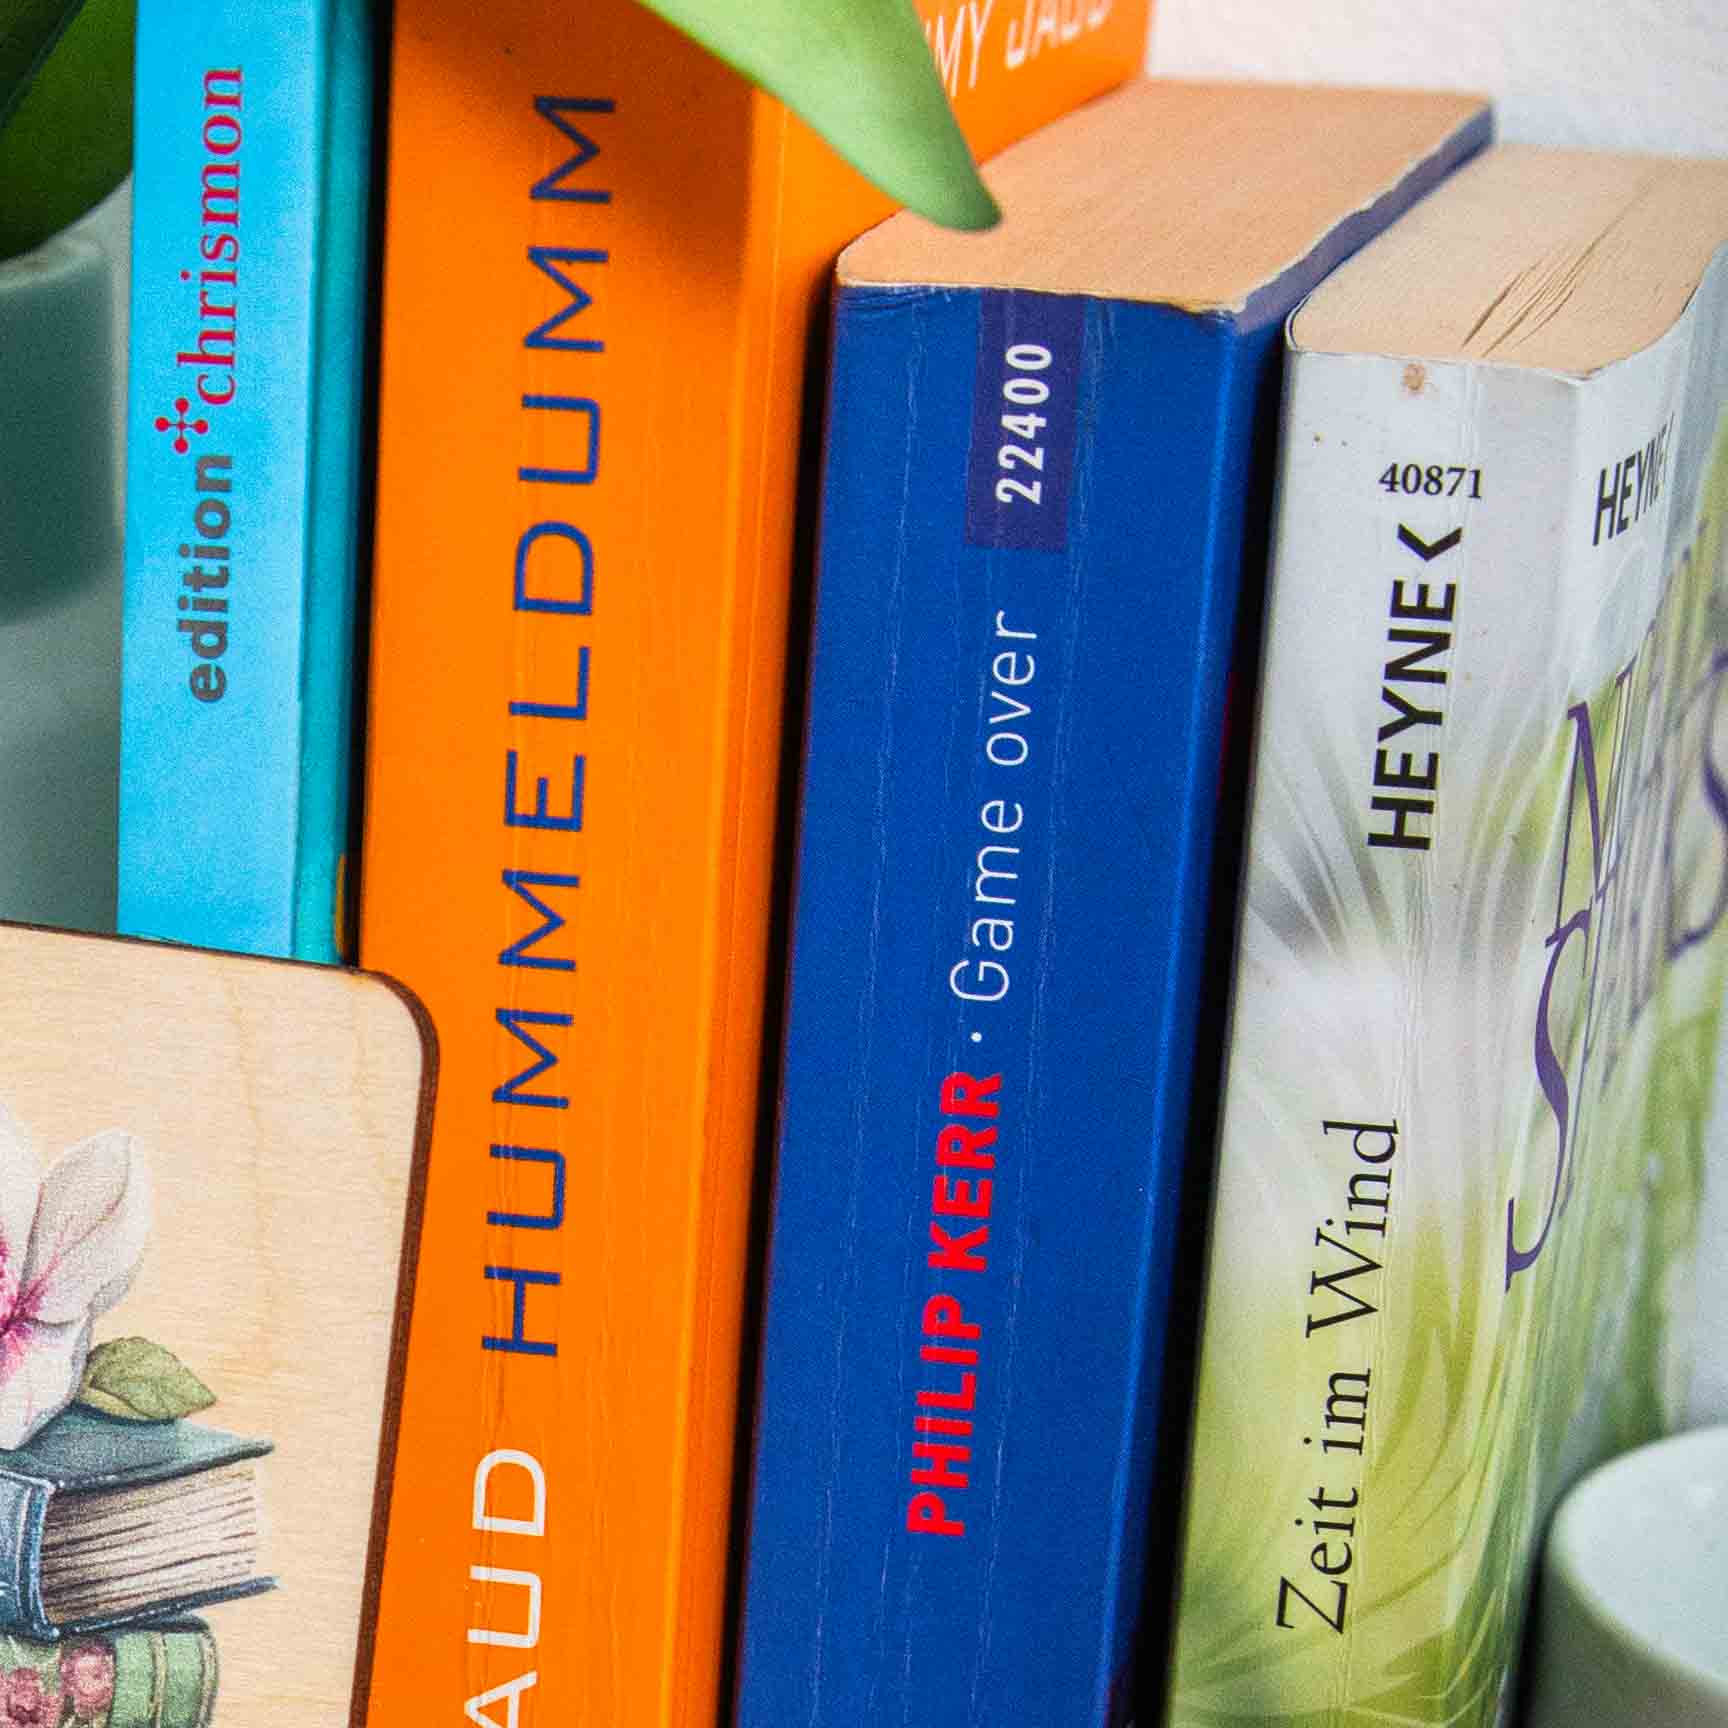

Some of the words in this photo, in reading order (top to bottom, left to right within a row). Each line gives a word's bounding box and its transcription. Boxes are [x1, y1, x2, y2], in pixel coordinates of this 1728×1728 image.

[176, 65, 242, 406] chrismon
[995, 343, 1052, 506] 22400
[1378, 462, 1483, 500] 40871
[176, 453, 233, 703] edition
[481, 95, 616, 1357] HUMMELDUMM
[985, 609, 1038, 768] over
[1367, 579, 1457, 851] HEYNE
[949, 799, 1024, 1003] Game
[928, 1072, 1004, 1273] KERR
[1305, 1118, 1400, 1340] Wind
[906, 1293, 982, 1537] PHILIP
[1303, 1367, 1372, 1457] im
[1276, 1486, 1359, 1635] Zeit
